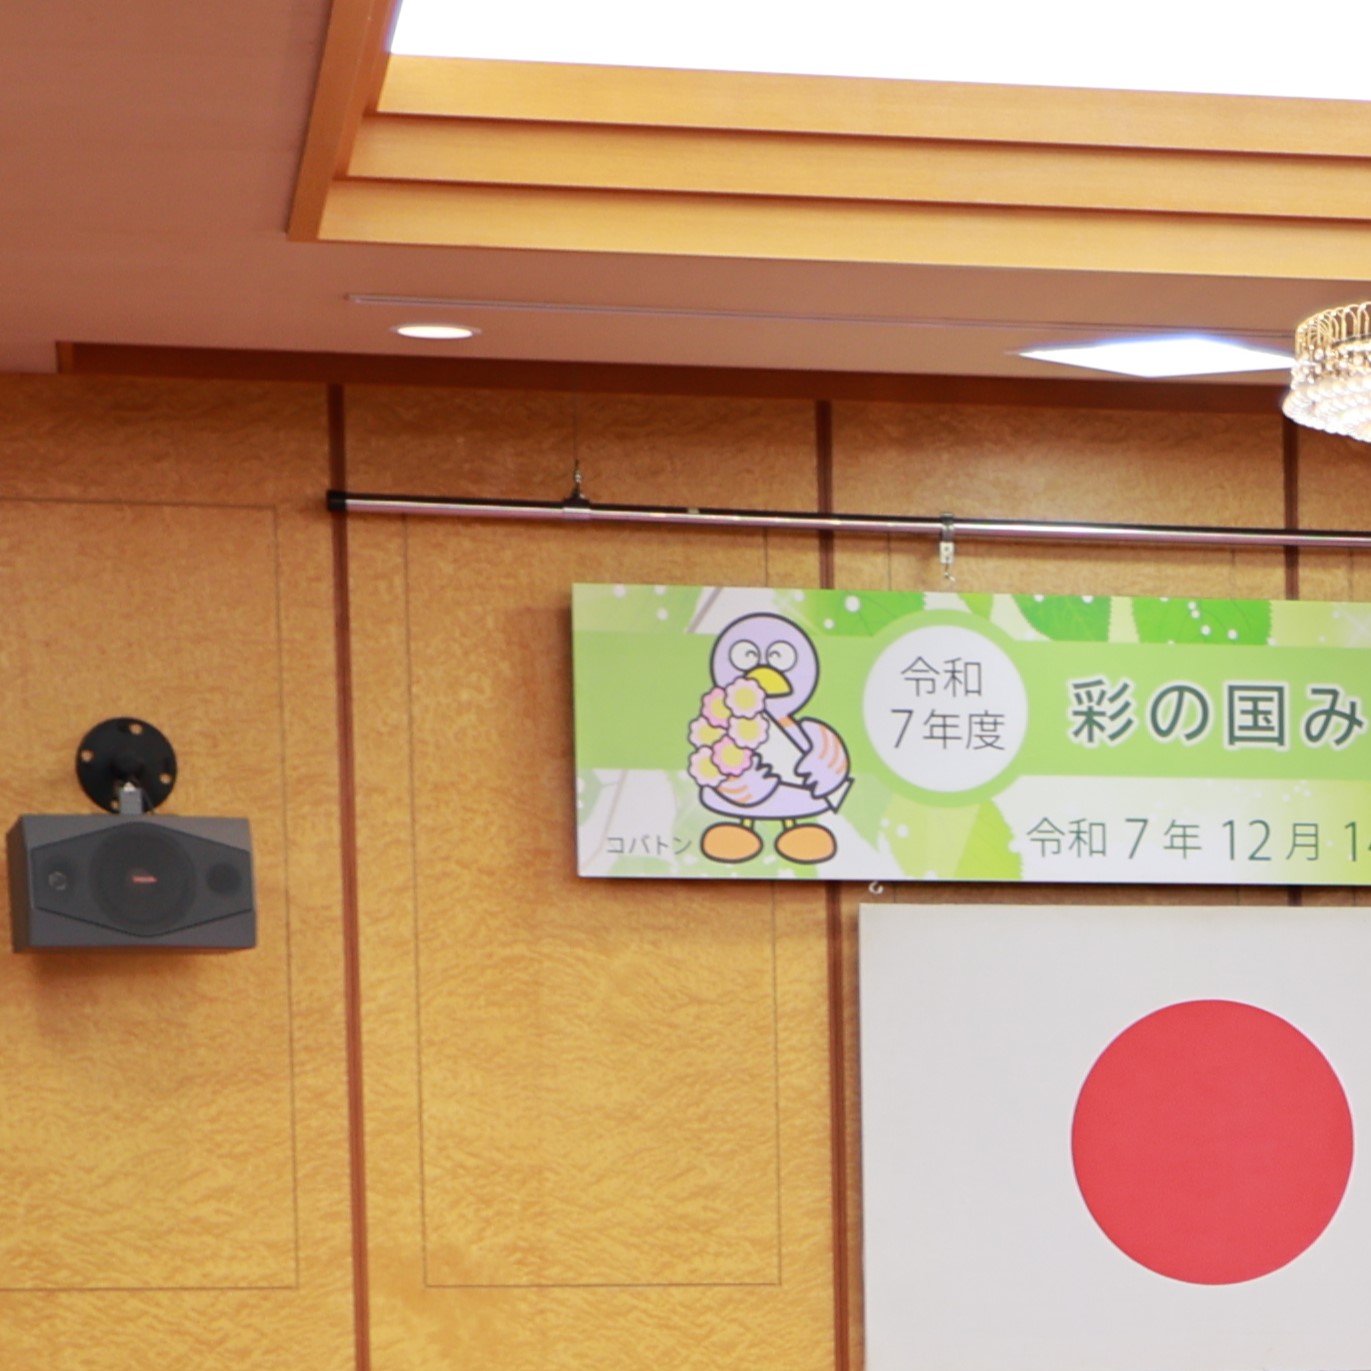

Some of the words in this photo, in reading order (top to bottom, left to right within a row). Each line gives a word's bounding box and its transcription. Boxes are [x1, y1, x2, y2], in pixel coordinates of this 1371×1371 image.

[901, 656, 982, 698] 令和
[890, 708, 1006, 751] 7年度
[606, 834, 692, 856] コバトン
